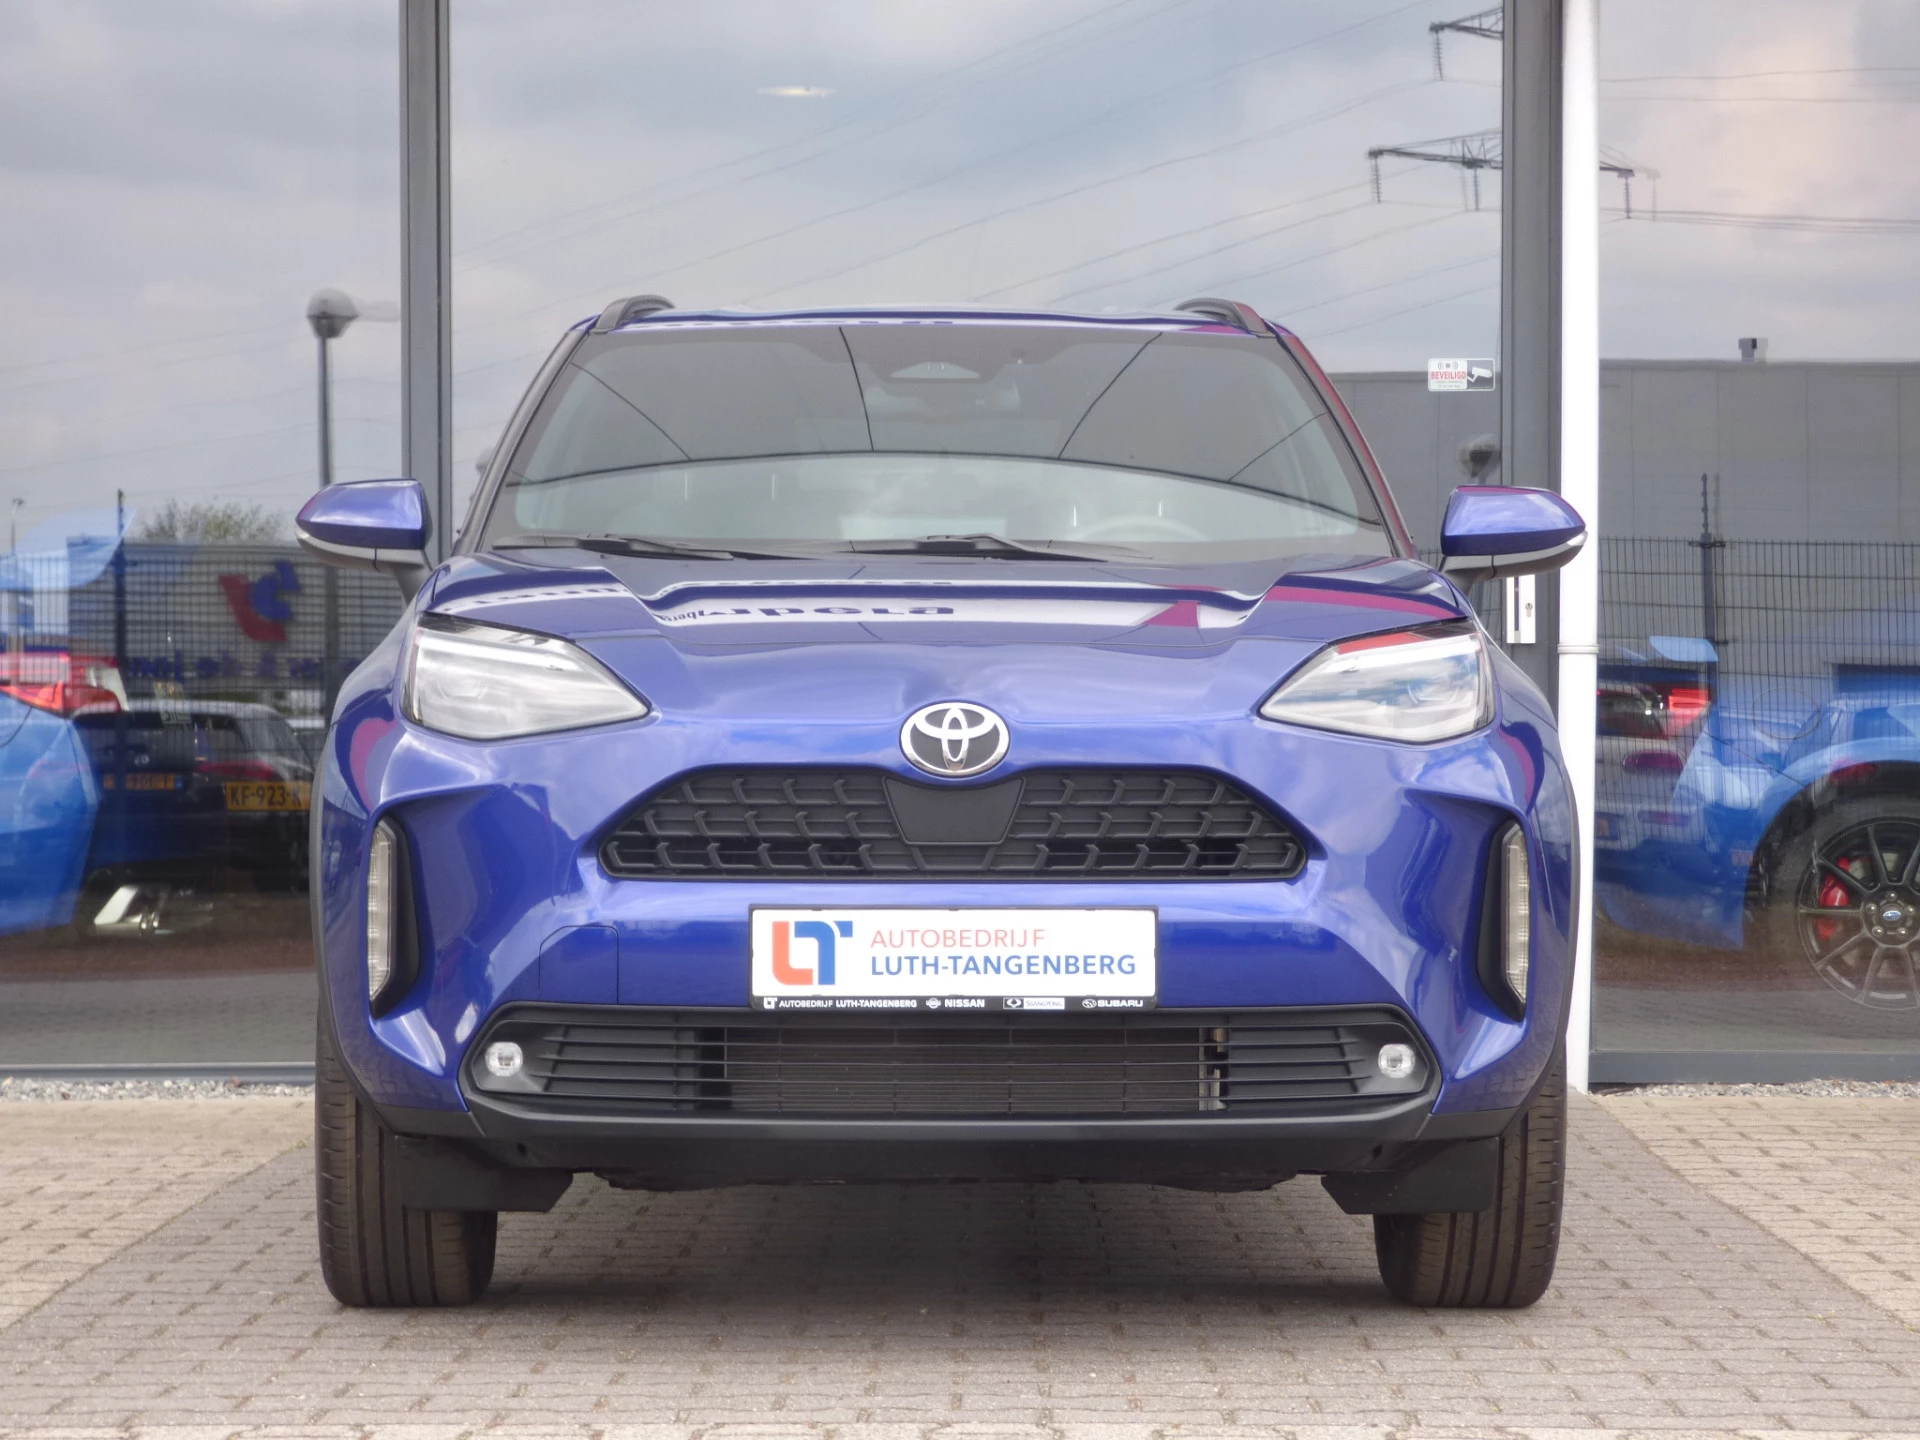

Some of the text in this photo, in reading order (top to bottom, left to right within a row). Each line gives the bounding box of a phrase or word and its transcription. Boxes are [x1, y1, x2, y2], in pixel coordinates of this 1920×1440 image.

[870, 929, 1045, 948] AUTOBEDRIJF
[871, 954, 1136, 976] LUTH-TANGENBERG
[779, 999, 833, 1009] AUTOBEDRIJF
[835, 999, 917, 1009] LUTH-TANGENBERG
[944, 999, 985, 1008] NISSAN
[1097, 999, 1144, 1008] SUBARU
